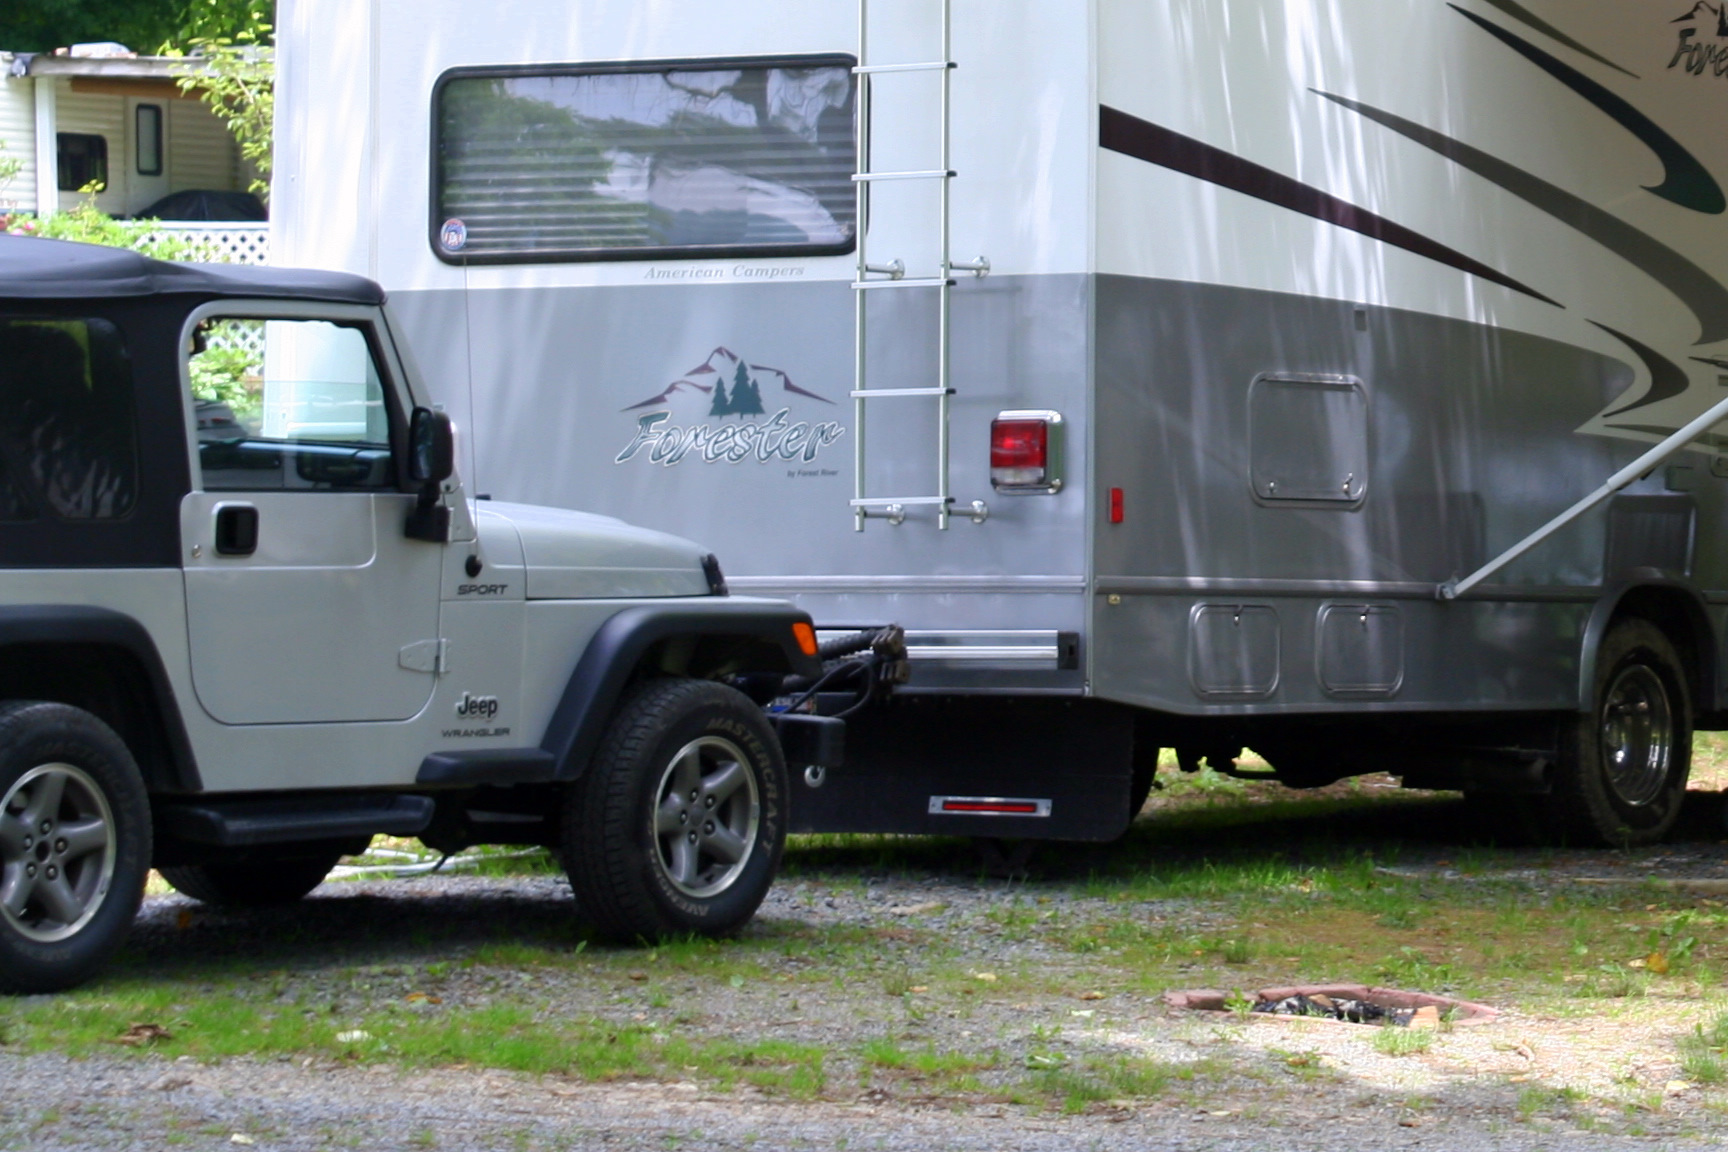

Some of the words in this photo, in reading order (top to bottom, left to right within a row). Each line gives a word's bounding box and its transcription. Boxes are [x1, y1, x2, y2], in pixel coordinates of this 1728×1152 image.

[644, 266, 724, 279] American
[733, 264, 805, 279] Campers
[615, 408, 846, 467] Forester
[457, 584, 508, 595] SPORT
[456, 693, 499, 719] Jeep
[441, 728, 511, 738] WRANGLER
